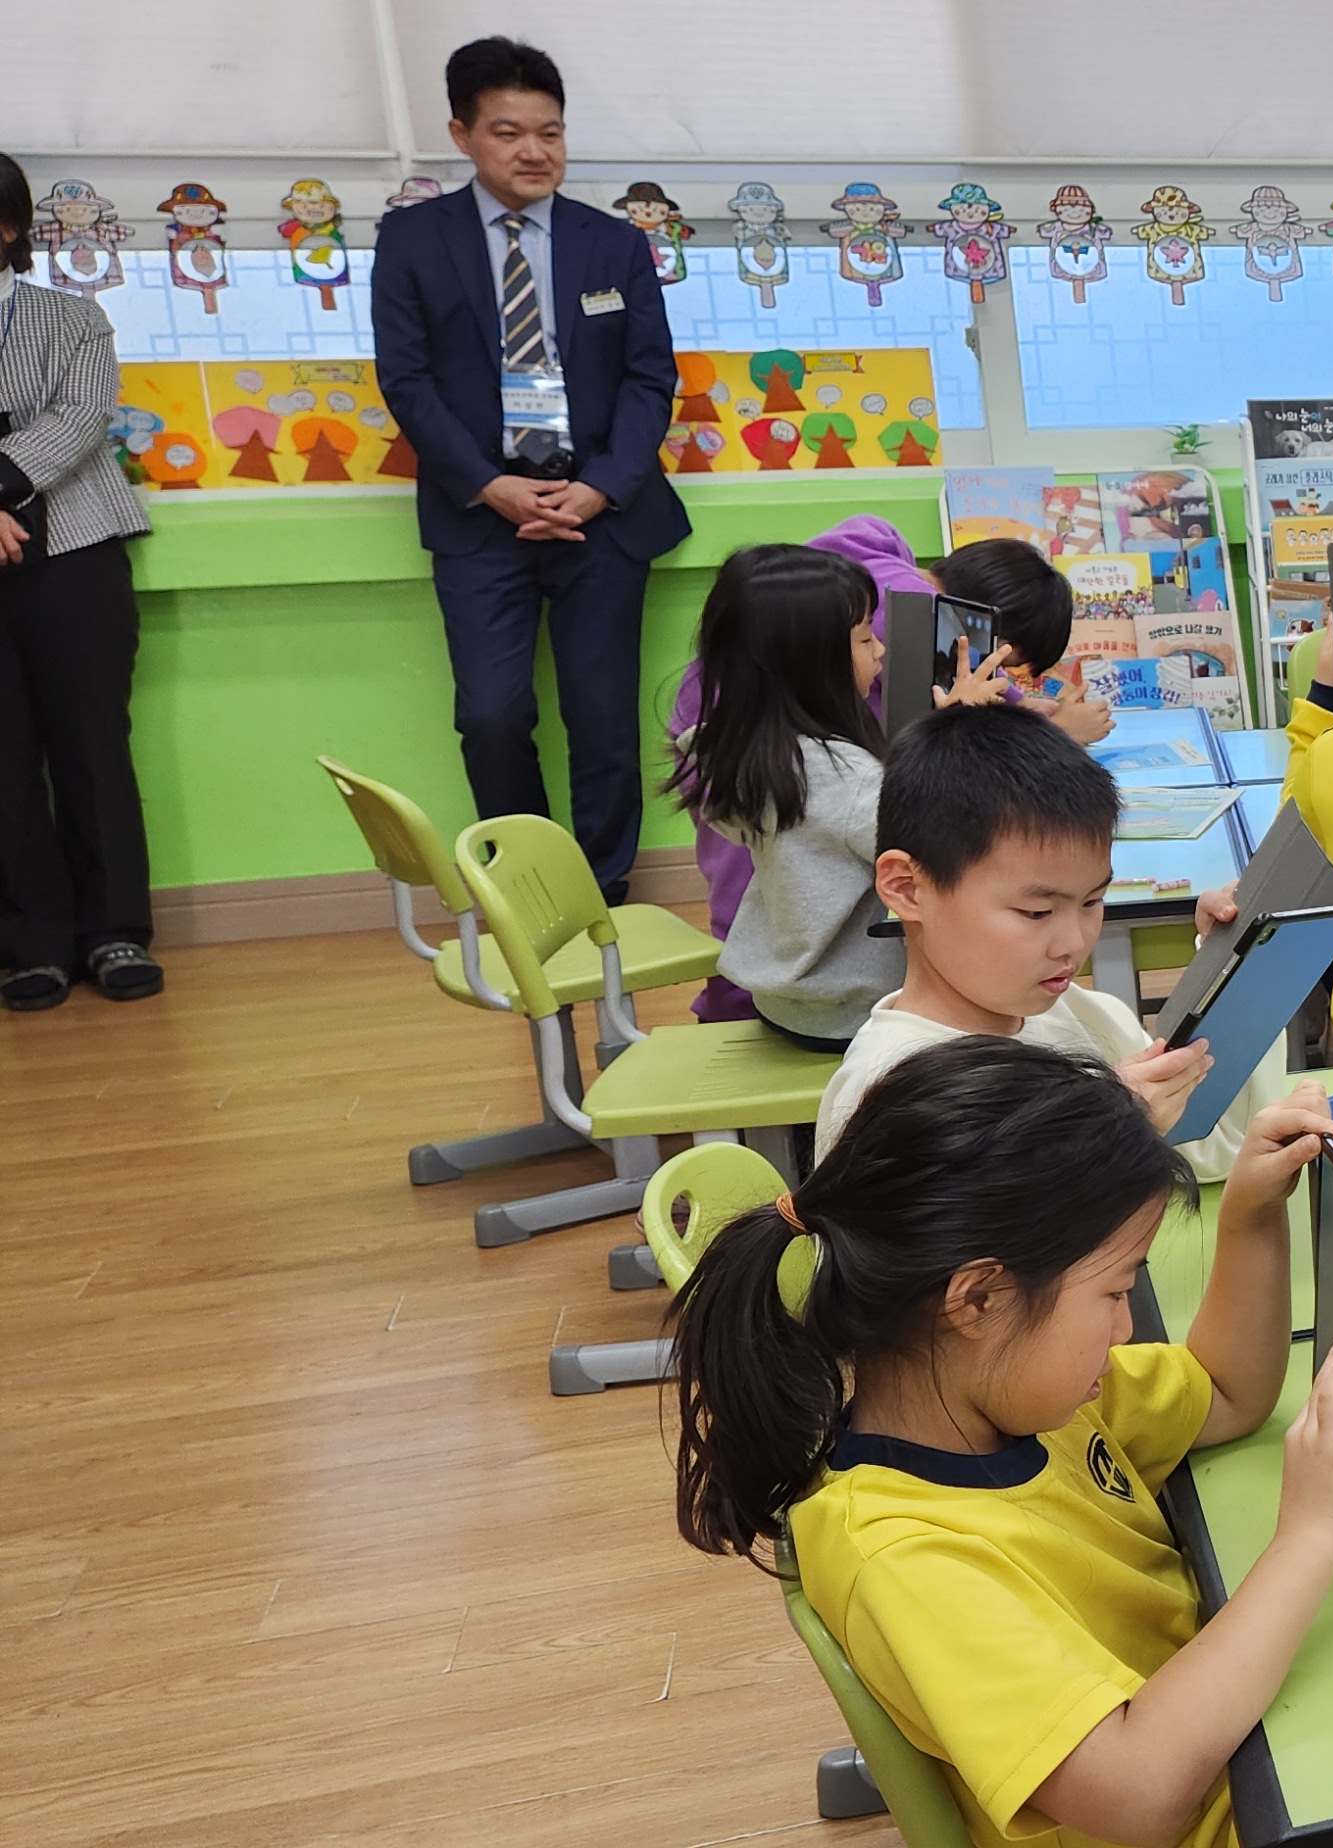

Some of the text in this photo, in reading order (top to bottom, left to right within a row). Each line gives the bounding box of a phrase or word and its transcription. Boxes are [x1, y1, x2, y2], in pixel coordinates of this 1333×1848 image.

[1275, 411, 1298, 421] 나의
[1300, 407, 1322, 424] 눈이
[1301, 422, 1322, 432] 너의
[1150, 686, 1182, 705] 장갑!
